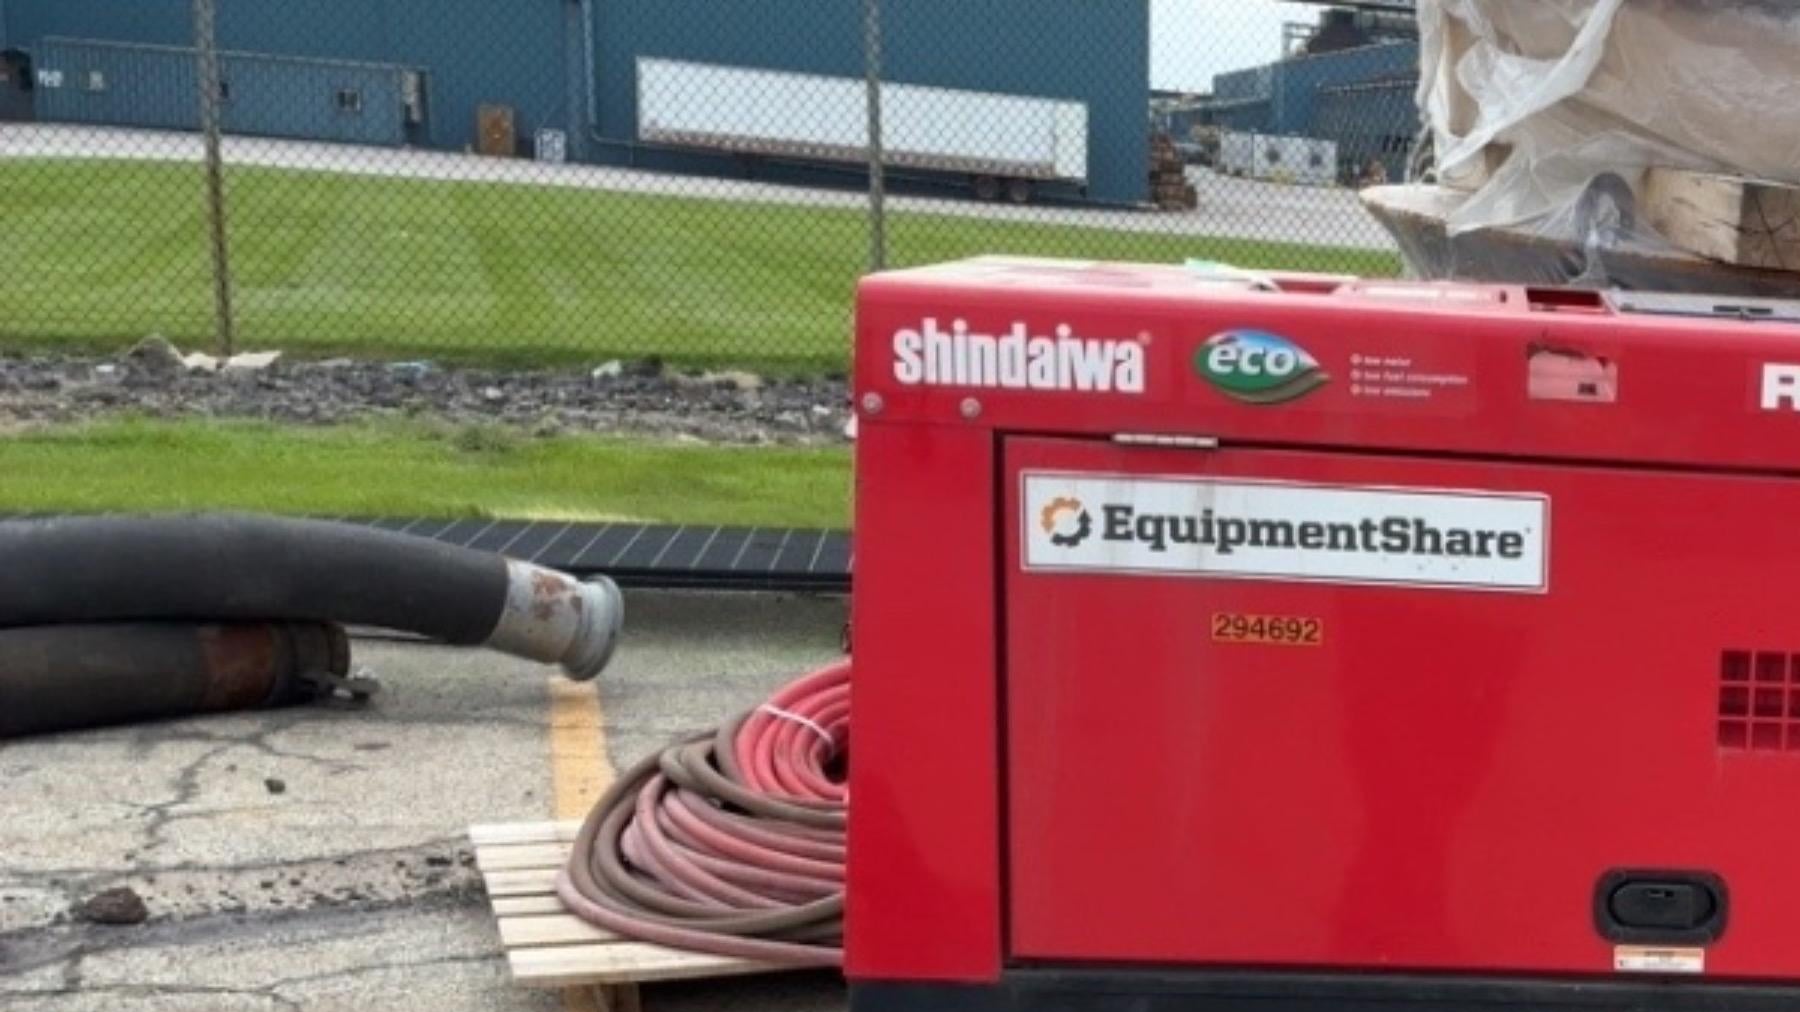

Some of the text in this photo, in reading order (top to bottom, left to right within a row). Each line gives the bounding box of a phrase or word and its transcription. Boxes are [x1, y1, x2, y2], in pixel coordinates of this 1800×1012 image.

[893, 317, 1144, 393] shindaiwa
[1101, 504, 1525, 559] EquipmentShare
[1215, 614, 1319, 642] 294692
